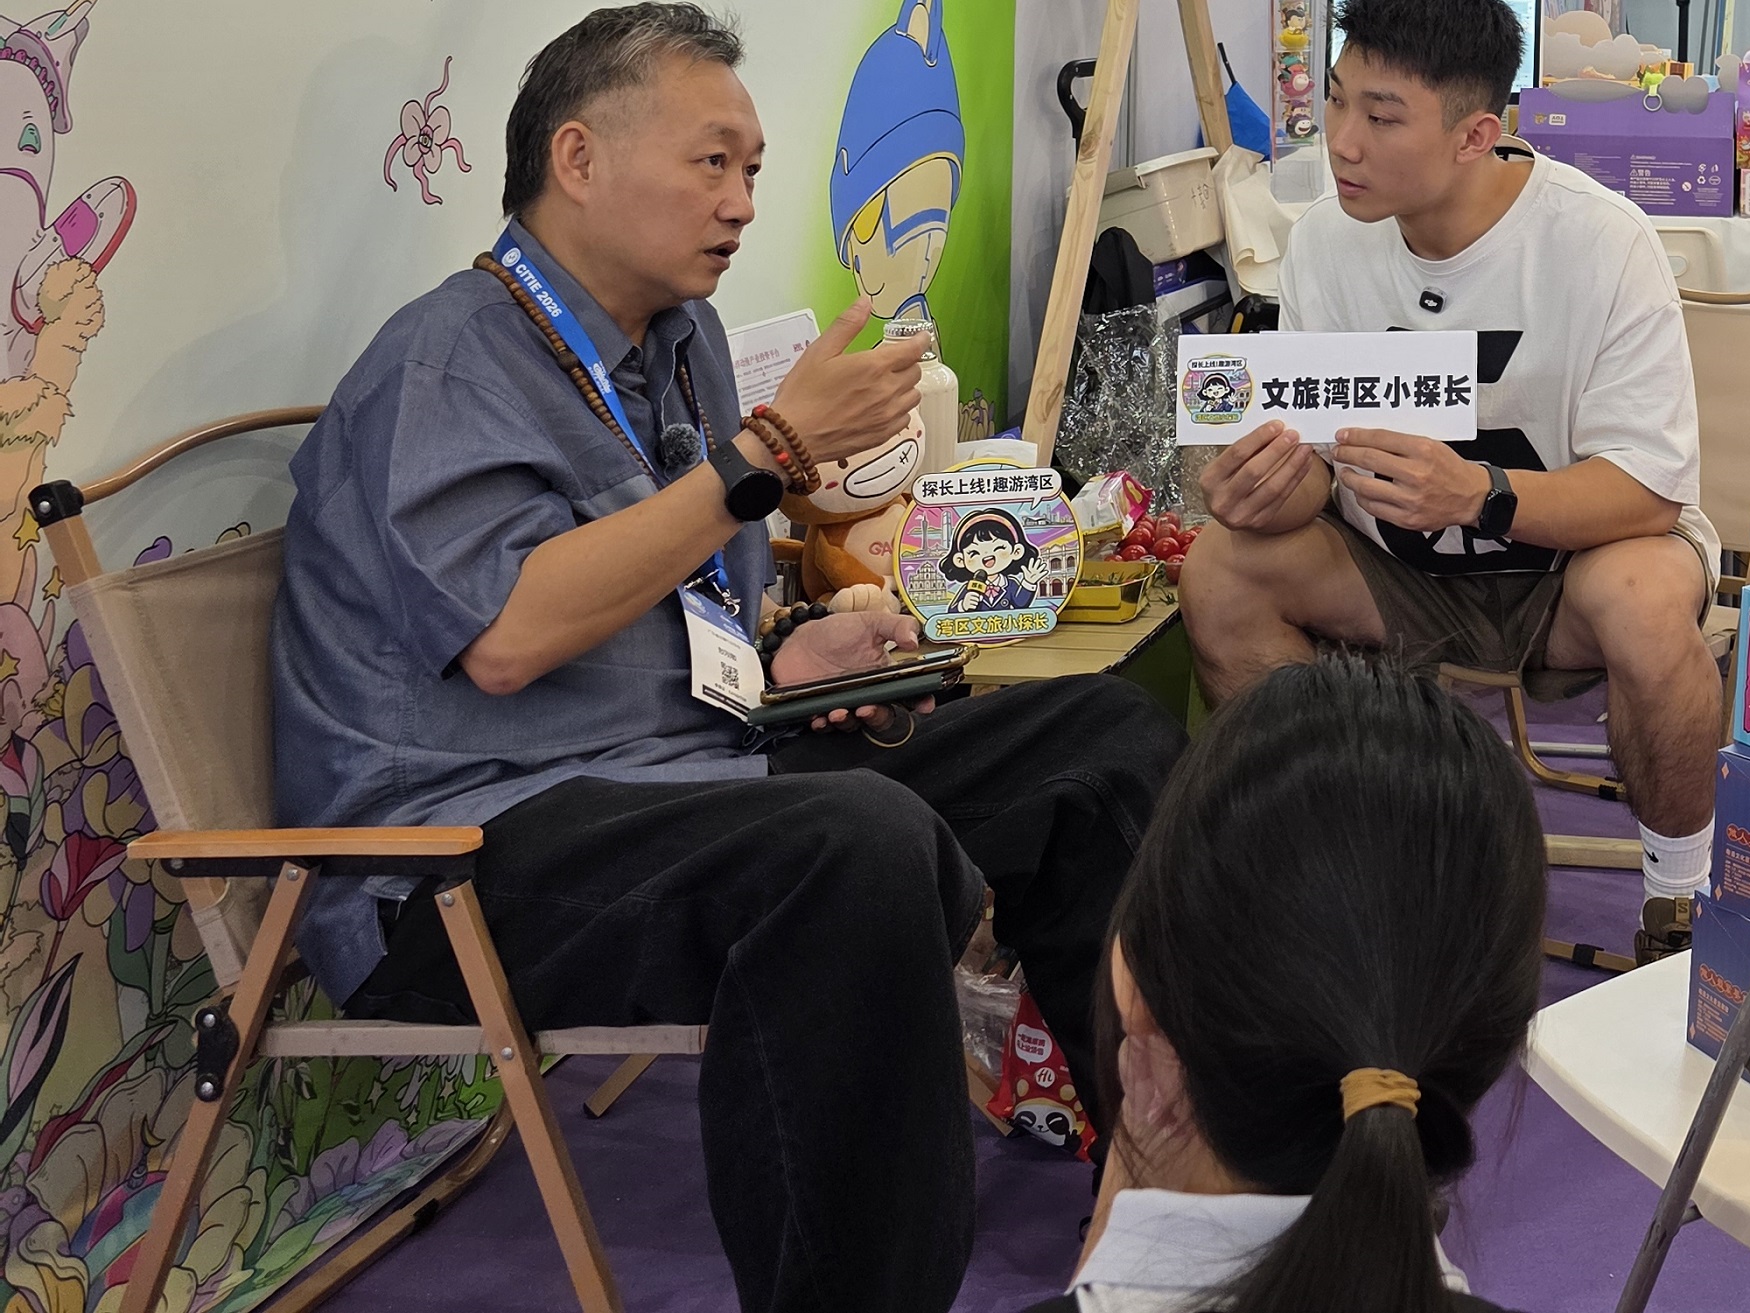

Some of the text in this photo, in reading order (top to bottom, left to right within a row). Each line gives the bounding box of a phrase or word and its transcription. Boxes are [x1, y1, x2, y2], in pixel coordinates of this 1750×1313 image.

[515, 263, 563, 318] CITIE 2026
[1261, 375, 1472, 410] 文旅湾区小探长
[922, 473, 1055, 498] 探长上线!趣游湾区
[935, 612, 1050, 637] 湾区文旅小探长
